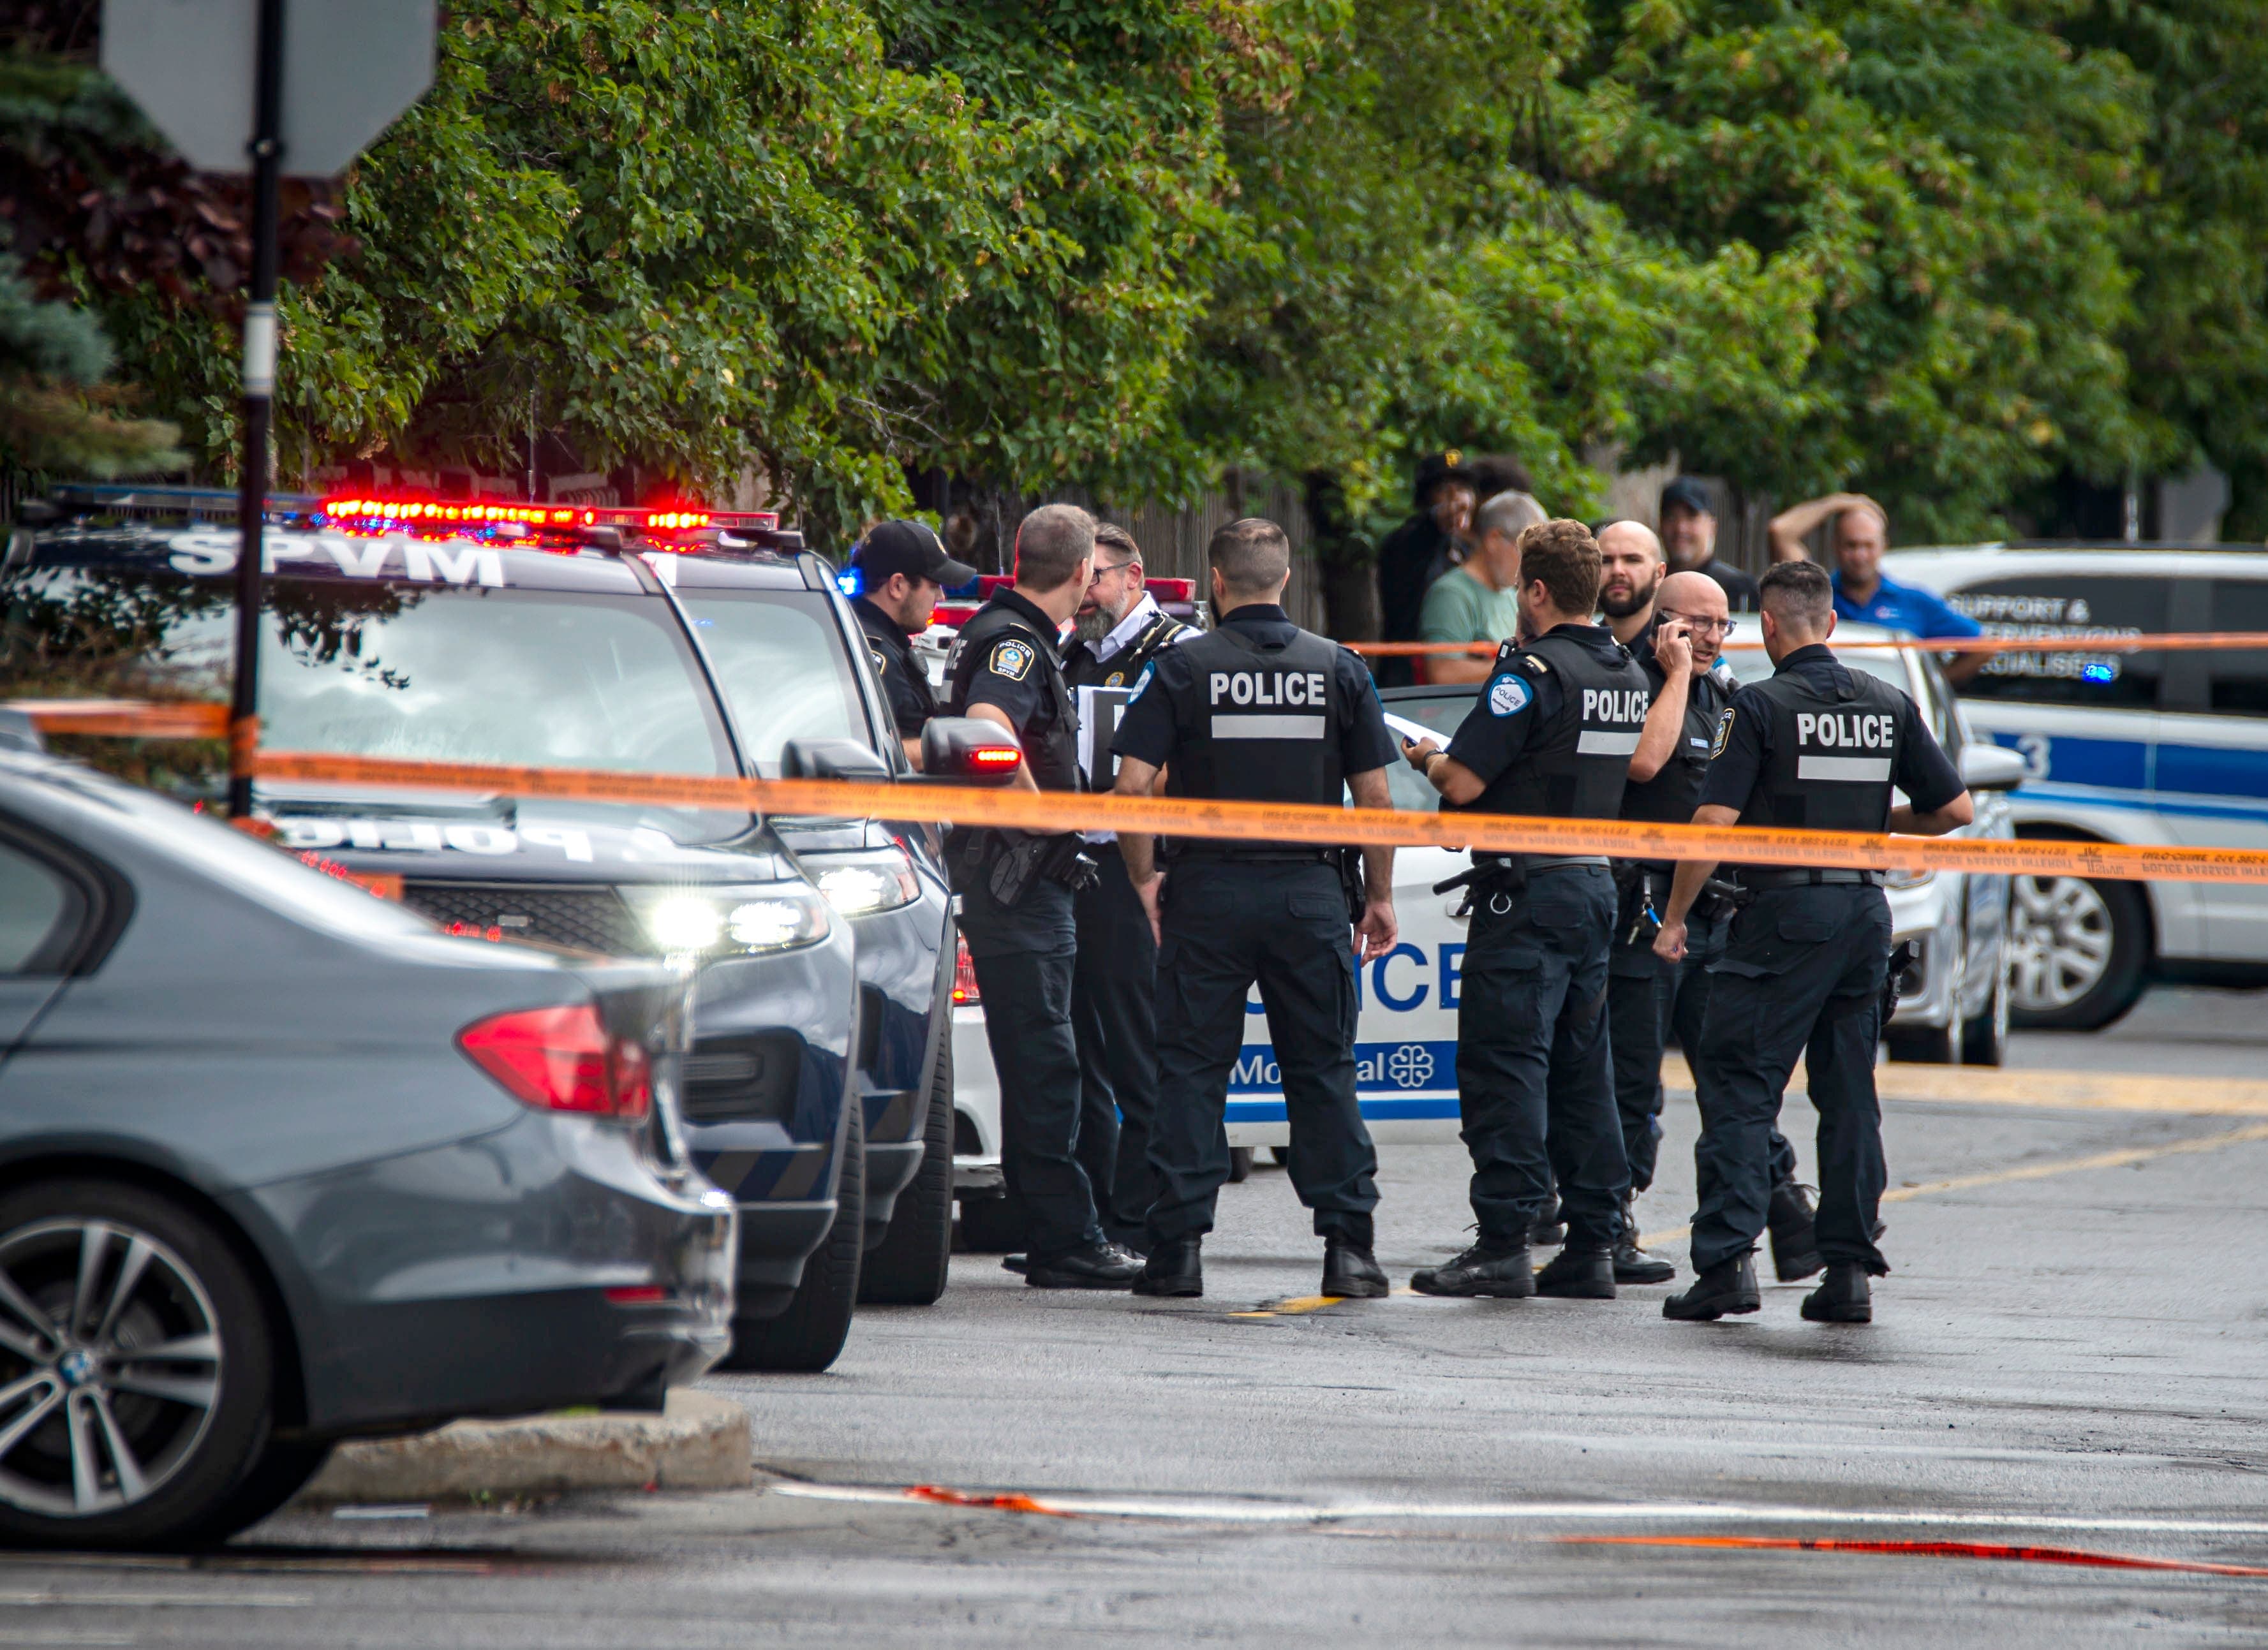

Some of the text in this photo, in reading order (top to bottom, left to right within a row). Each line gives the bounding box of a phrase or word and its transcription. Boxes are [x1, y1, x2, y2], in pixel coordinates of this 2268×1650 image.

[167, 532, 504, 587] SPVM
[998, 641, 1032, 658] POLICE
[997, 667, 1016, 677] SPVM
[1210, 672, 1326, 705] POLICE
[1493, 686, 1521, 707] POLICE
[1583, 689, 1649, 723] POLICE
[1797, 713, 1893, 748] POLICE
[1229, 1051, 1385, 1086] Moal
